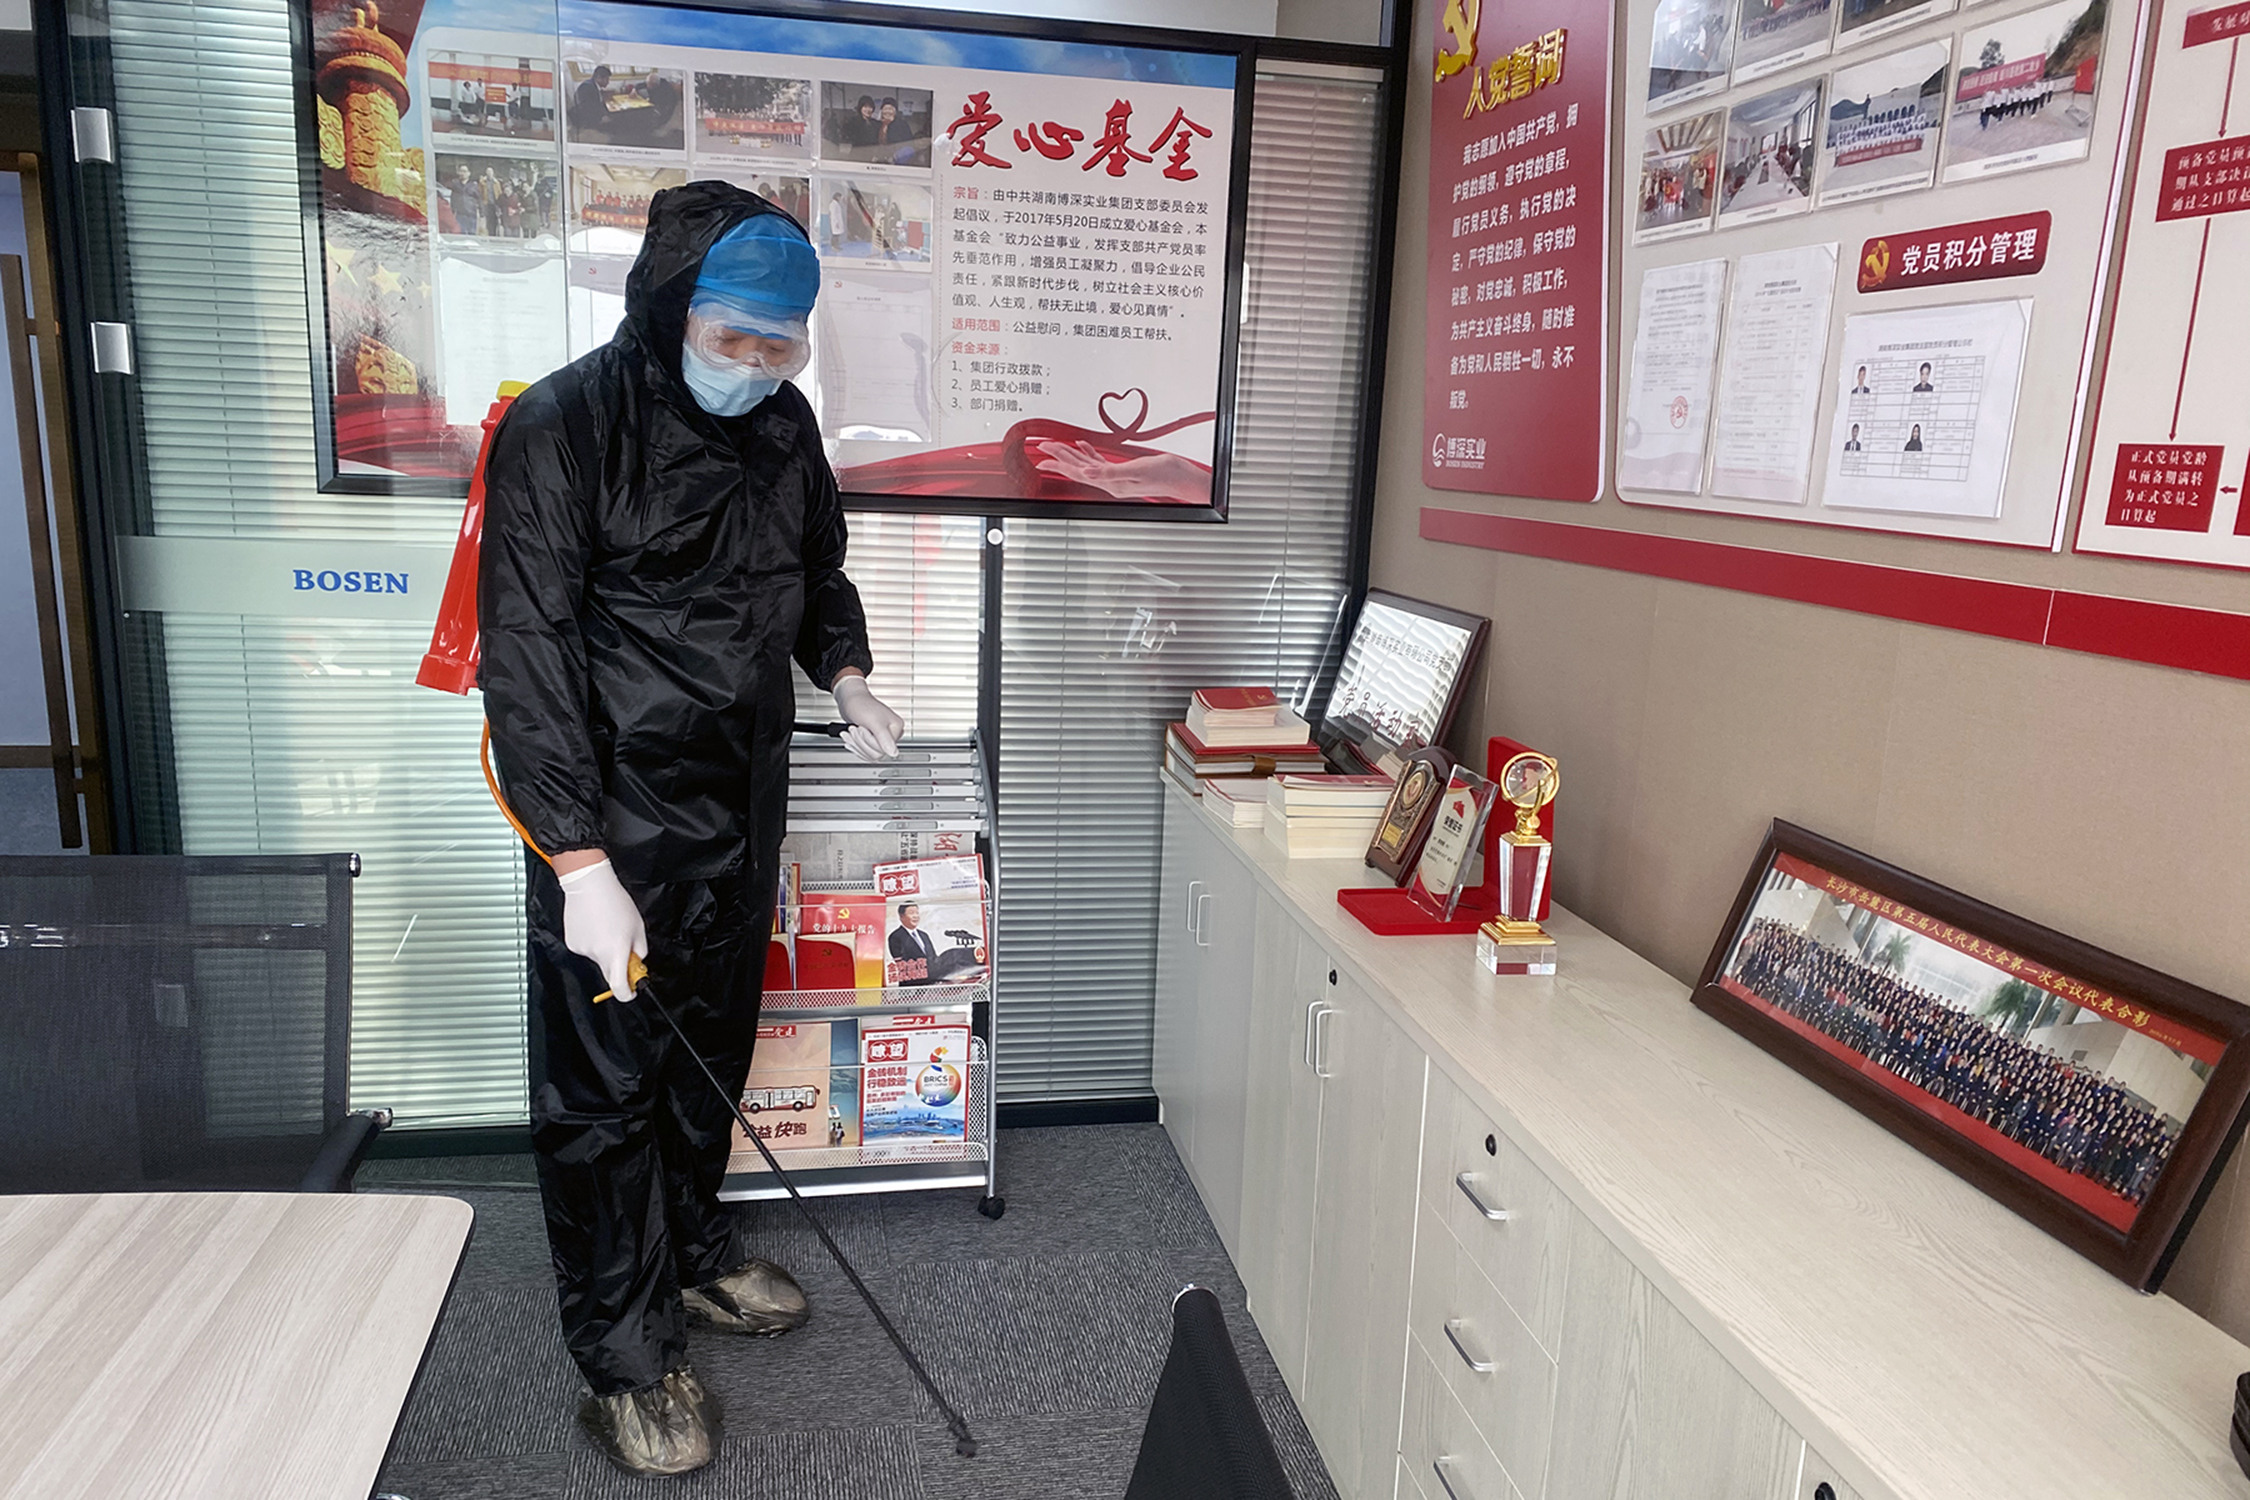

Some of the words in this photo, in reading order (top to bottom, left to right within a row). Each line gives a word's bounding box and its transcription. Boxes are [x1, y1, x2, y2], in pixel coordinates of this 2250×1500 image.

[946, 91, 1213, 181] 爱心基金
[1463, 103, 1578, 165] 我志愿加入中国共产党，拥
[1452, 148, 1570, 204] 护党的纲领，遵守党的章程，
[1452, 184, 1576, 239] 履行党员义务，执行党的决
[1451, 225, 1576, 273] 定，严守党的纪律，保守党的
[1900, 228, 2038, 276] 党员积分管理
[952, 251, 1205, 278] 先垂范作用，增强员工凝聚力，倡导企业公民
[952, 272, 1204, 299] 责任，紧跟新时代步伐，树立社会主义核心价
[1451, 267, 1568, 307] 秘密，对党忠诚，积极工作，
[952, 318, 1172, 342] 适用范围：公益慰问，集团困难员工帮扶。
[1450, 305, 1575, 341] 为共产主义奋斗终身，随时准
[1450, 346, 1575, 376] 备为党和人民牺牲一切，永不
[951, 398, 1024, 412] 3、部门捐赠。
[2131, 450, 2207, 466] 正式党员党龄
[2127, 469, 2203, 486] 从预备期满转
[2124, 489, 2200, 507] 为正式党员之
[2120, 508, 2157, 523] 日算起
[293, 569, 409, 594] BOSEN
[1826, 875, 2151, 1028] 长沙市岳麓区第五届人民代表大会第一次会议代表合影
